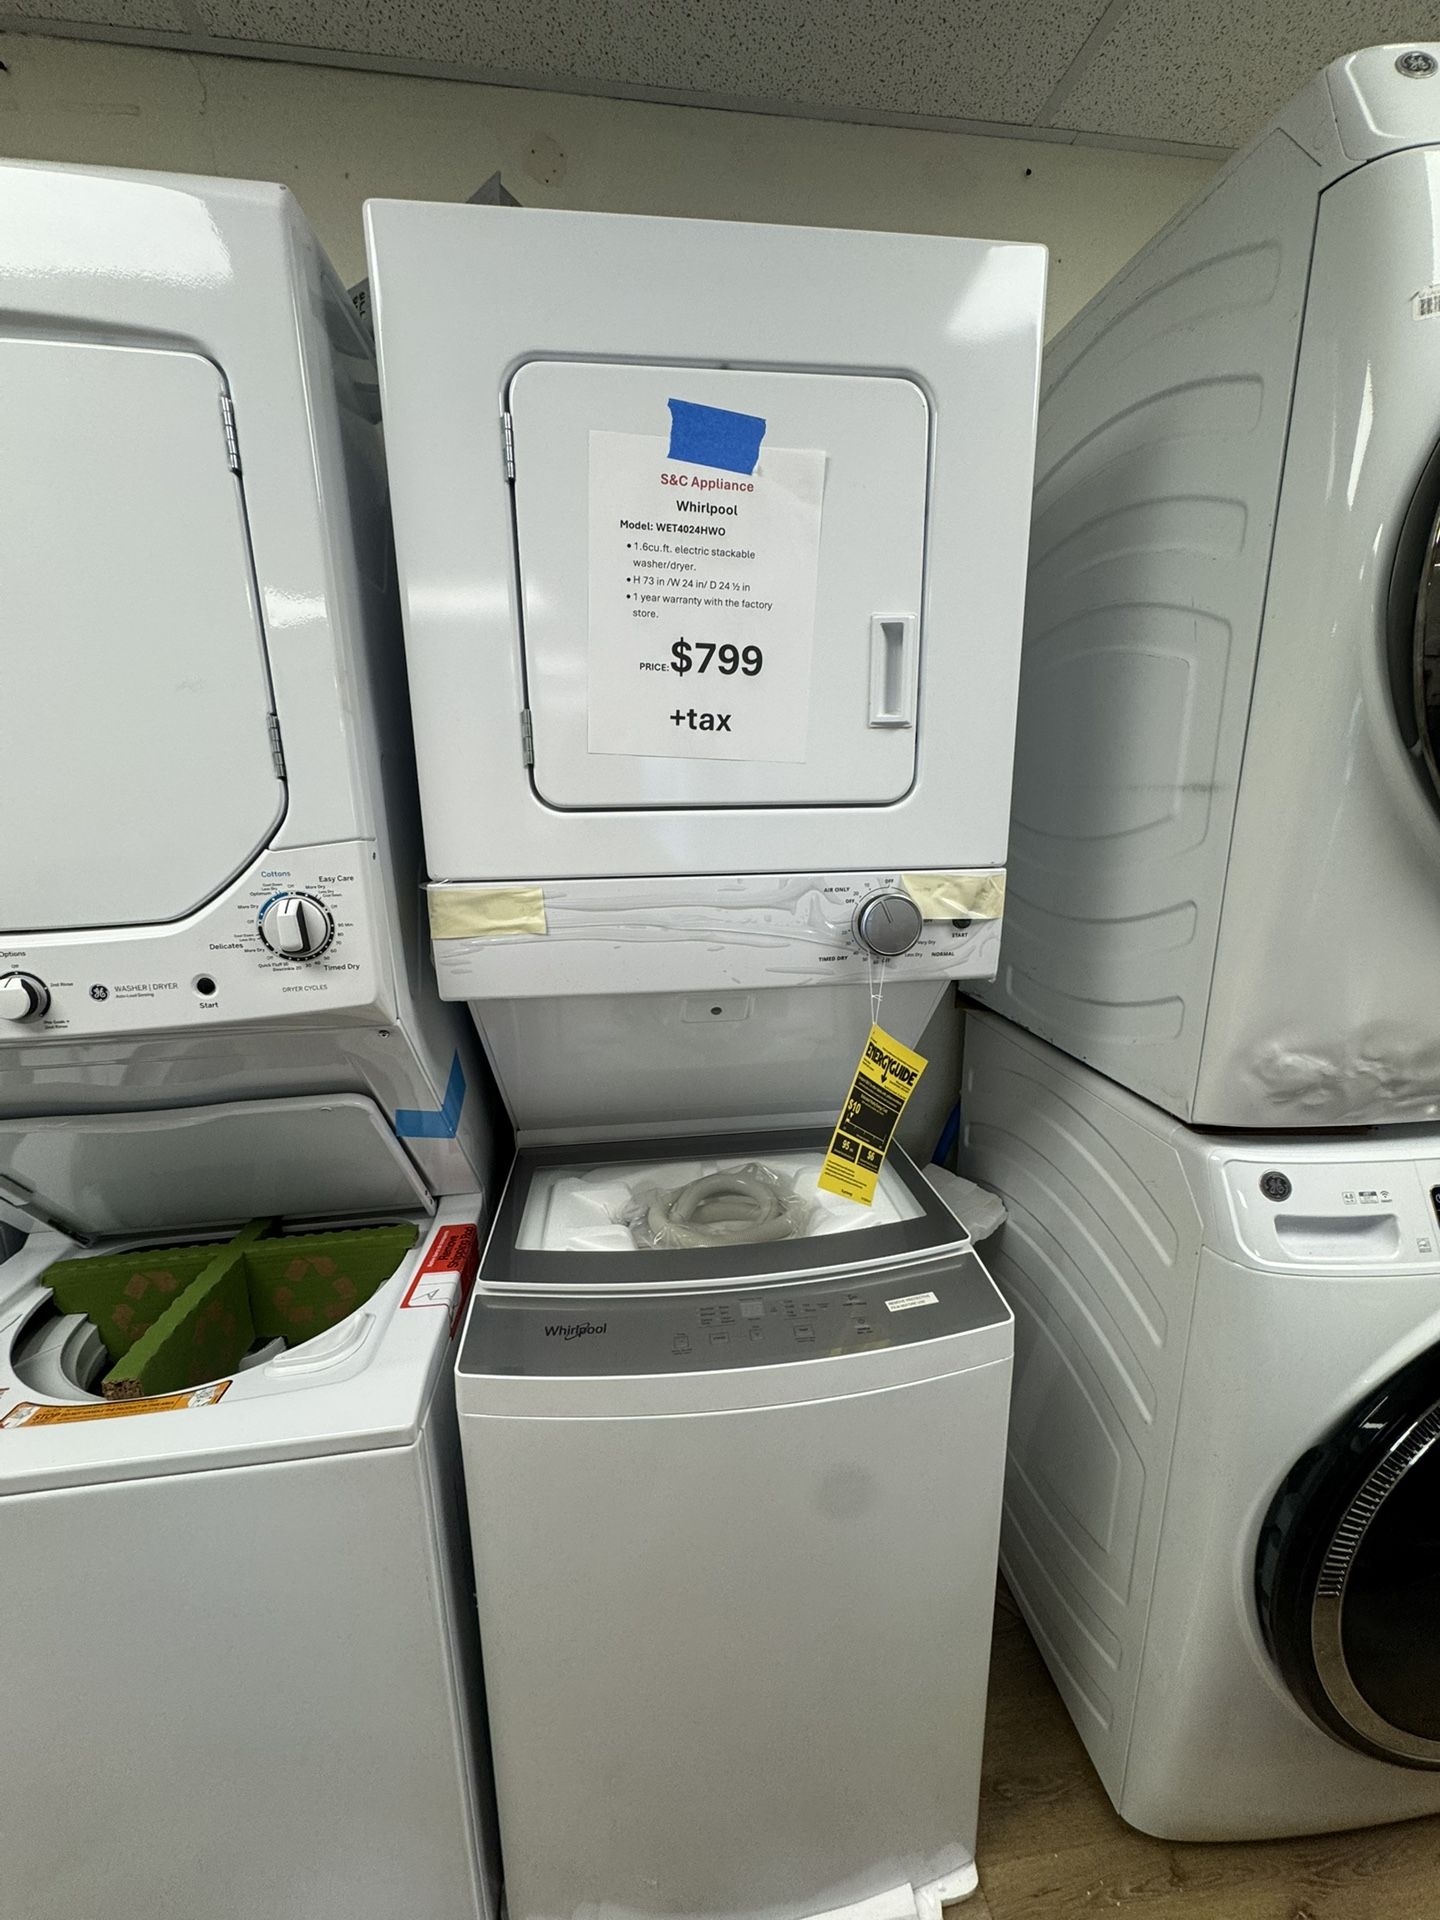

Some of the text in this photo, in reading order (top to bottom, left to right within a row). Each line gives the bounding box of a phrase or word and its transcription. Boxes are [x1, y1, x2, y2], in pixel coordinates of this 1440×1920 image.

[660, 473, 754, 492] S&C Appliance
[676, 500, 738, 516] Whirlpool
[620, 519, 654, 531] Model:
[634, 542, 755, 560] 1.6cu.ft. electric stackable
[633, 559, 697, 572] washer/dryer.
[633, 576, 641, 584] H
[643, 576, 655, 586] 73
[656, 577, 665, 586] in
[682, 579, 693, 588] 24
[695, 580, 708, 589] in/
[710, 581, 717, 589] D
[719, 581, 730, 590] 24
[742, 583, 750, 592] in
[633, 592, 773, 611] 1 year warranty with the factory
[632, 609, 659, 619] store.
[639, 637, 763, 677] PRICE: $799
[670, 708, 733, 732] +tax
[209, 942, 244, 951] Delicates
[0, 951, 26, 959] Options
[347, 963, 360, 971] Dry
[114, 983, 179, 992] WASHER DRYER
[282, 984, 328, 993] DRYER CYCLES
[199, 1001, 219, 1009] Start
[848, 1099, 861, 1114] $10
[544, 1322, 608, 1341] Whirlpool
